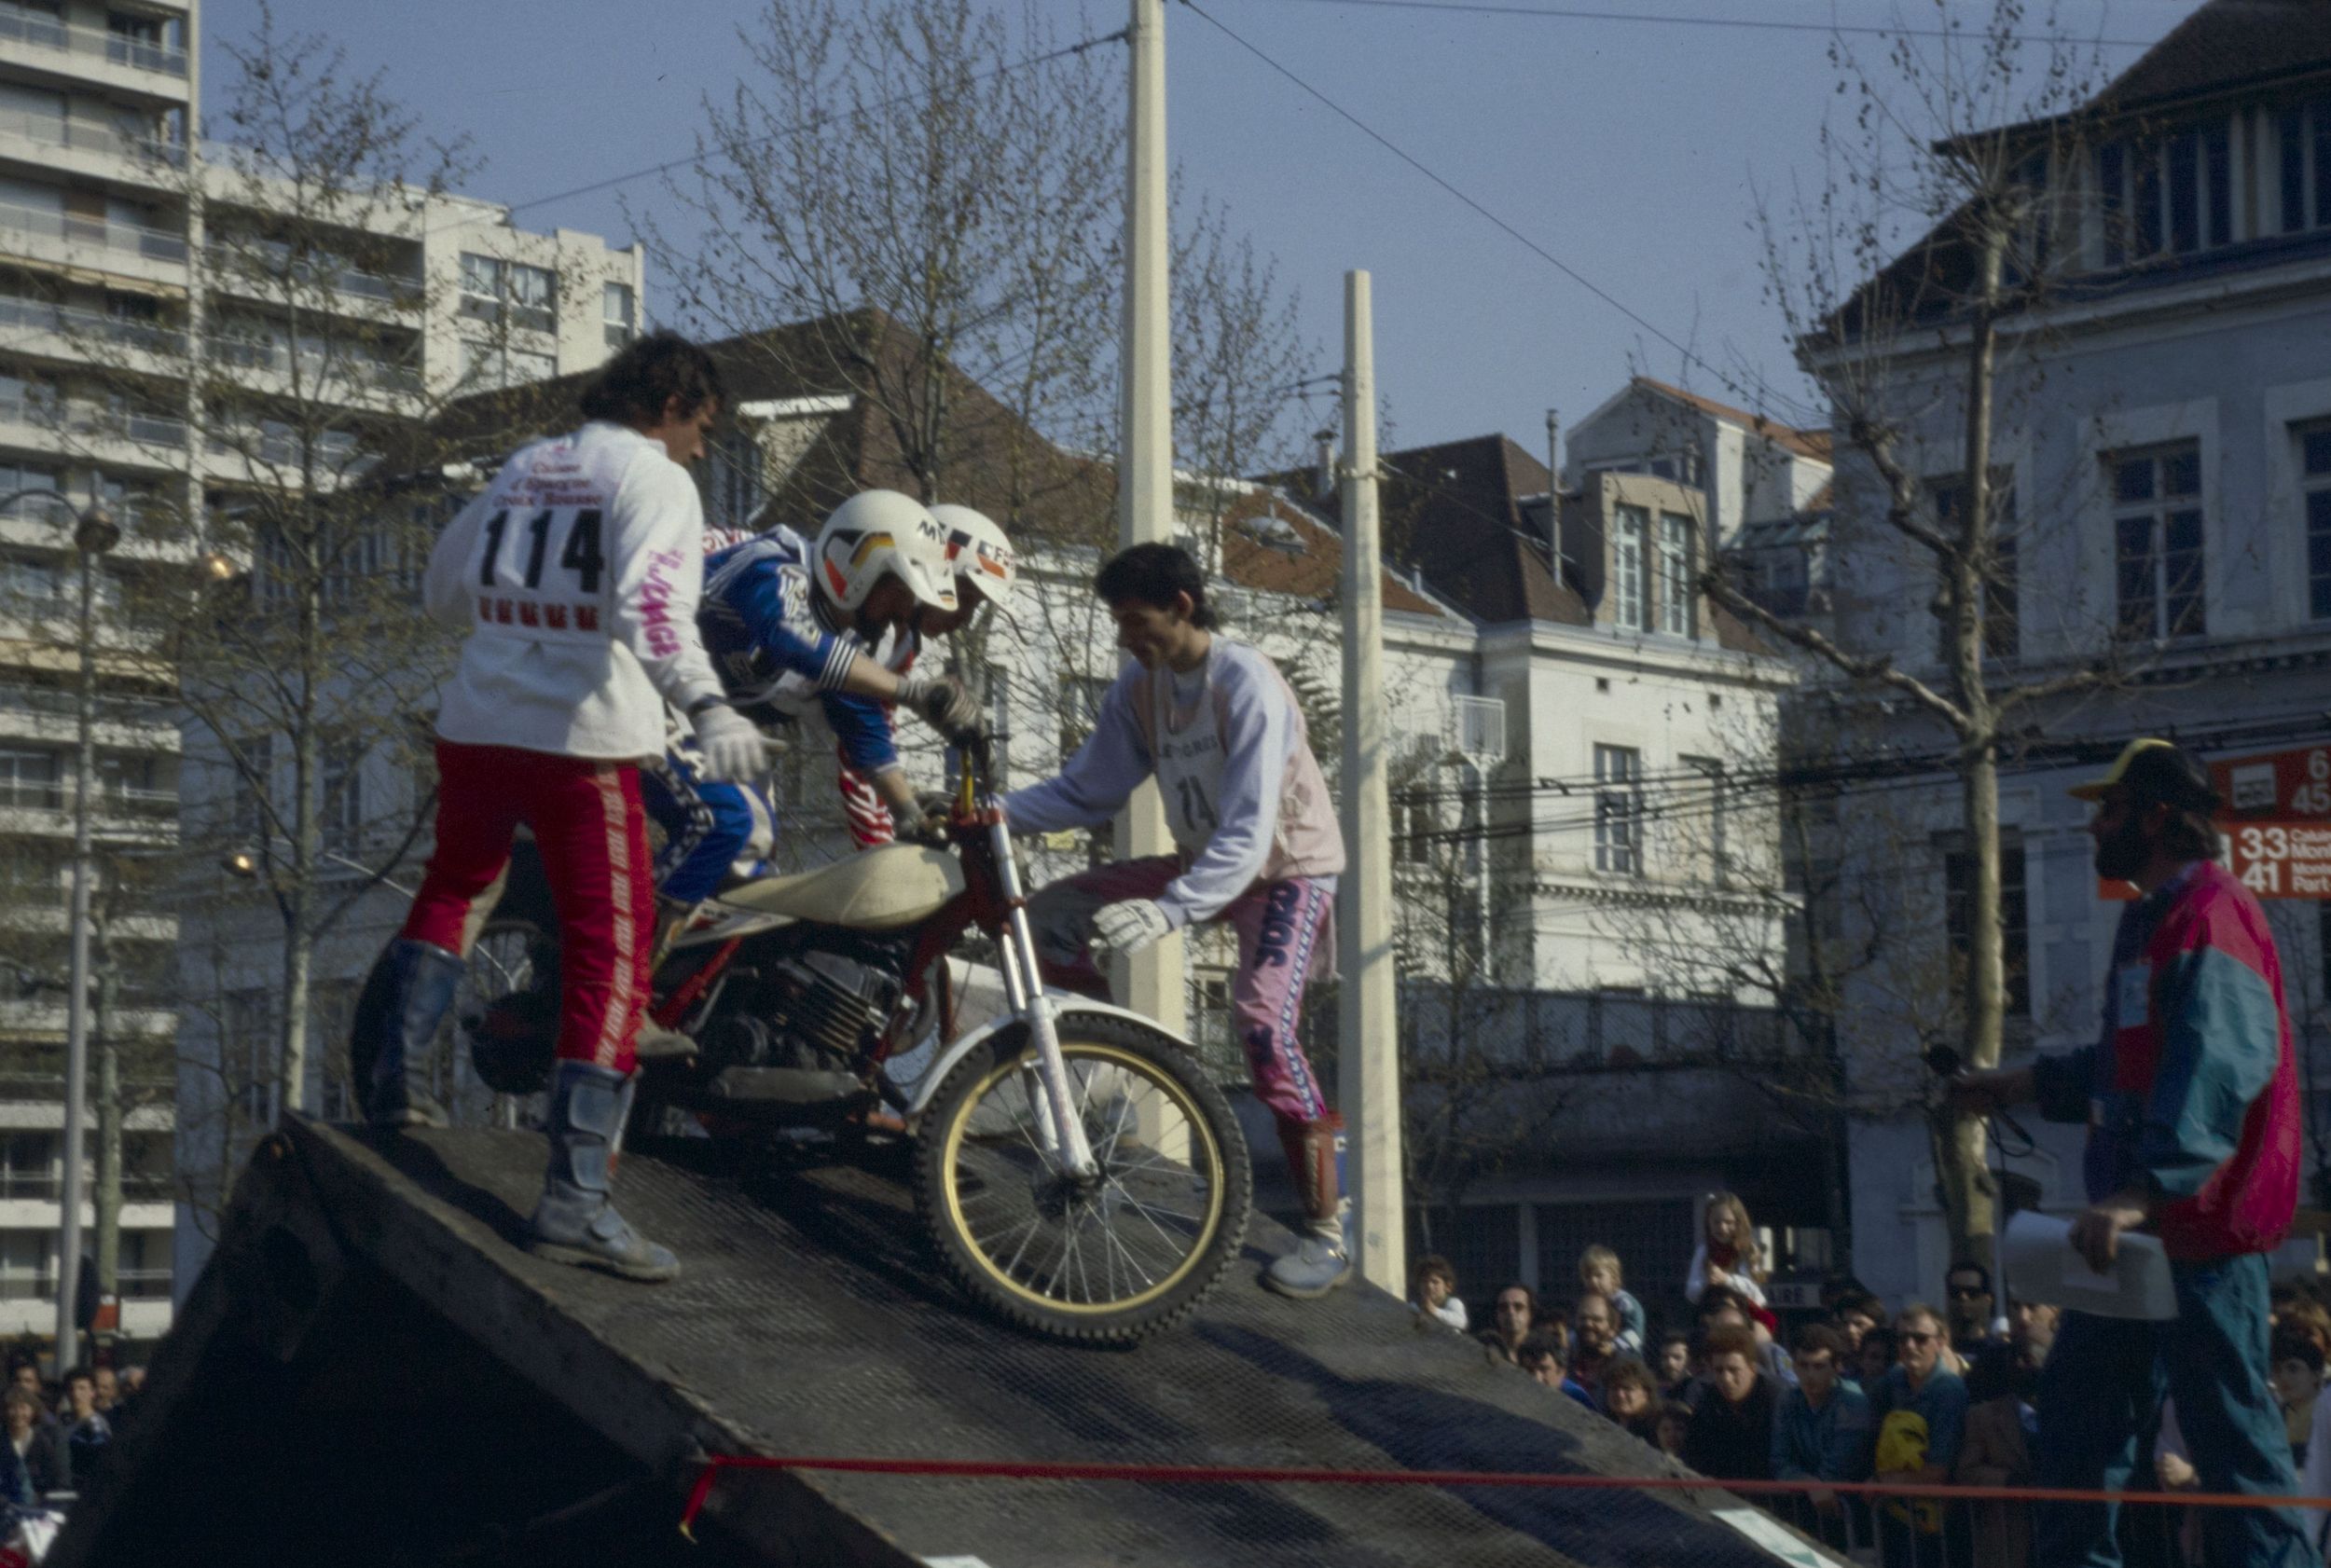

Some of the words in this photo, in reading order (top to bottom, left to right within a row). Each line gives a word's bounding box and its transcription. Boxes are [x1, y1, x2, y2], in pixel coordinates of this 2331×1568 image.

[480, 509, 605, 594] 114
[2309, 750, 2329, 779] 6
[2292, 782, 2331, 814] 45
[2240, 827, 2290, 860] 33
[2241, 860, 2281, 893] 41
